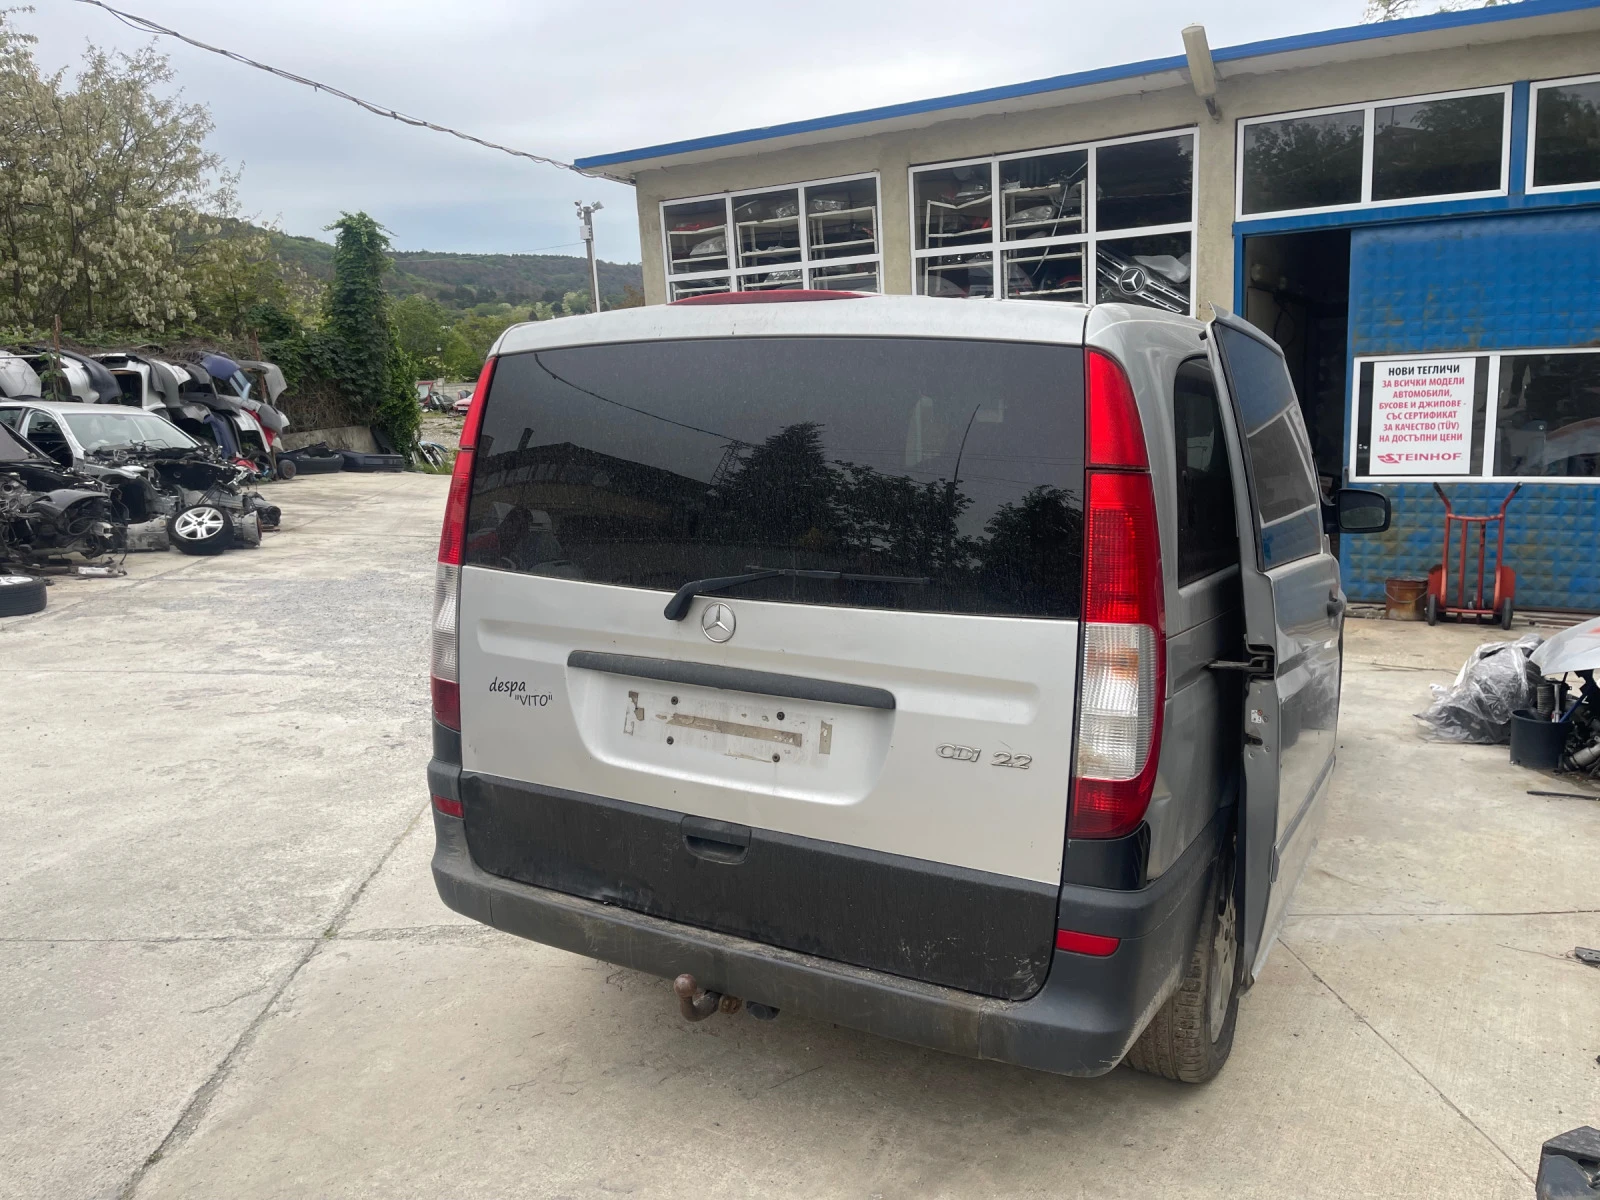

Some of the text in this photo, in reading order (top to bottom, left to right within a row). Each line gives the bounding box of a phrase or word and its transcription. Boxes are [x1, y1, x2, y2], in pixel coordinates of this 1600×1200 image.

[1388, 364, 1460, 376] НОВИ ТЕГЛИЧИ
[1382, 377, 1465, 388] ЗА ВСИЧКИ МОДЕЛИ
[1393, 389, 1453, 398] АВТОМОБИЛИ,
[1379, 401, 1409, 410] БУСОВЕ
[1418, 399, 1462, 409] ДЖИПОВЕ
[1386, 410, 1457, 420] СЪС СЕРТИФИКАТ
[1383, 423, 1393, 431] ЗА
[1395, 422, 1436, 431] КАЧЕСТВО
[1379, 432, 1463, 444] НА ДОСТЪПНИ ЦЕНИ
[1377, 452, 1462, 464] STEINHOF
[489, 676, 526, 698] despa
[514, 694, 553, 707] "VITO"
[936, 743, 981, 762] CDI
